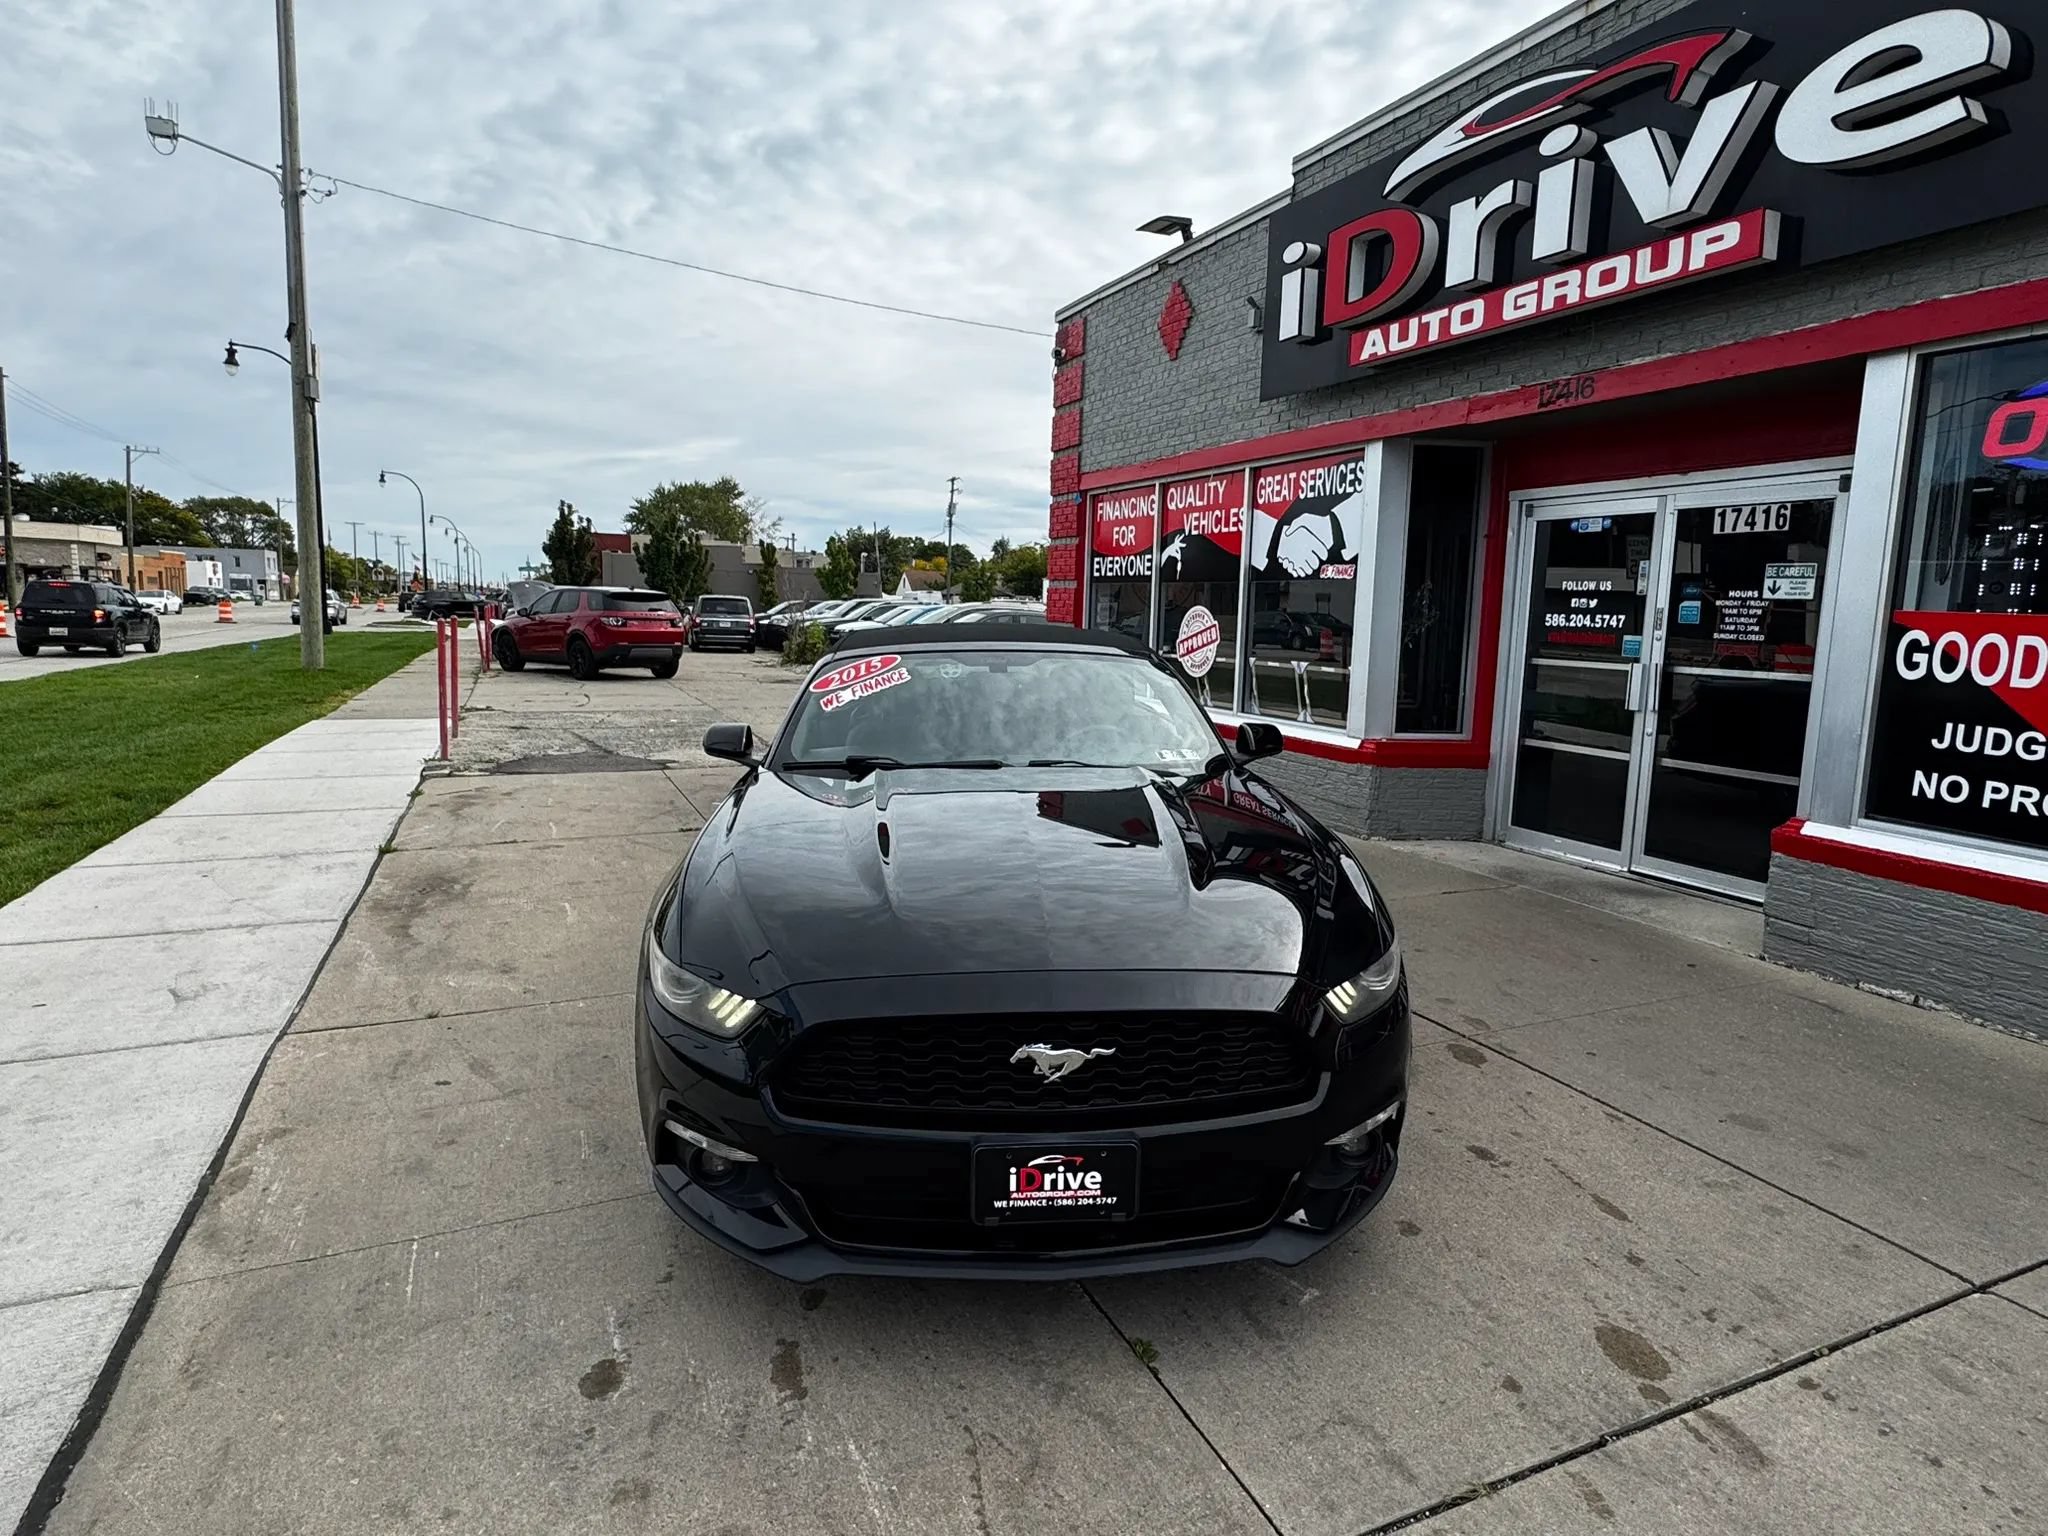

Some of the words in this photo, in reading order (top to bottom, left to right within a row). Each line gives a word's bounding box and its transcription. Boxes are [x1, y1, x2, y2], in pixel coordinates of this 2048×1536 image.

[1278, 8, 2004, 343] iDrive
[1358, 298, 1485, 361] AUTO
[1502, 221, 1741, 323] GROUP
[1167, 480, 1226, 511] QUALITY
[1257, 472, 1297, 504] GREAT
[1298, 460, 1365, 500] SERVICES
[1097, 494, 1157, 522] FINANCING
[1717, 504, 1789, 532] 17416
[1112, 526, 1136, 547] FOR
[1093, 555, 1152, 577] EVERYONE
[1767, 567, 1778, 577] BE
[1779, 567, 1815, 577] CAREFUL
[1562, 581, 1597, 591] FOLLOW
[1600, 581, 1612, 591] US
[1728, 590, 1759, 598] HOURS
[1544, 613, 1626, 628] 586.204.5747
[1179, 626, 1217, 656] APPROVED
[1739, 633, 1765, 641] CLOSED
[829, 657, 882, 688] 2015
[1896, 629, 2048, 689] GOOD
[822, 694, 845, 709] WE
[851, 671, 908, 697] FINANCE
[1931, 722, 2047, 761] JUDG
[1912, 769, 1970, 803] NO
[1982, 780, 2048, 816] PR
[1009, 1166, 1102, 1191] iDrive
[1009, 1200, 1047, 1208] FINANCE
[1053, 1198, 1076, 1207] (586)
[1077, 1197, 1117, 1206] 204-5747
[1010, 1190, 1101, 1199] AUTOGROUP.COM
